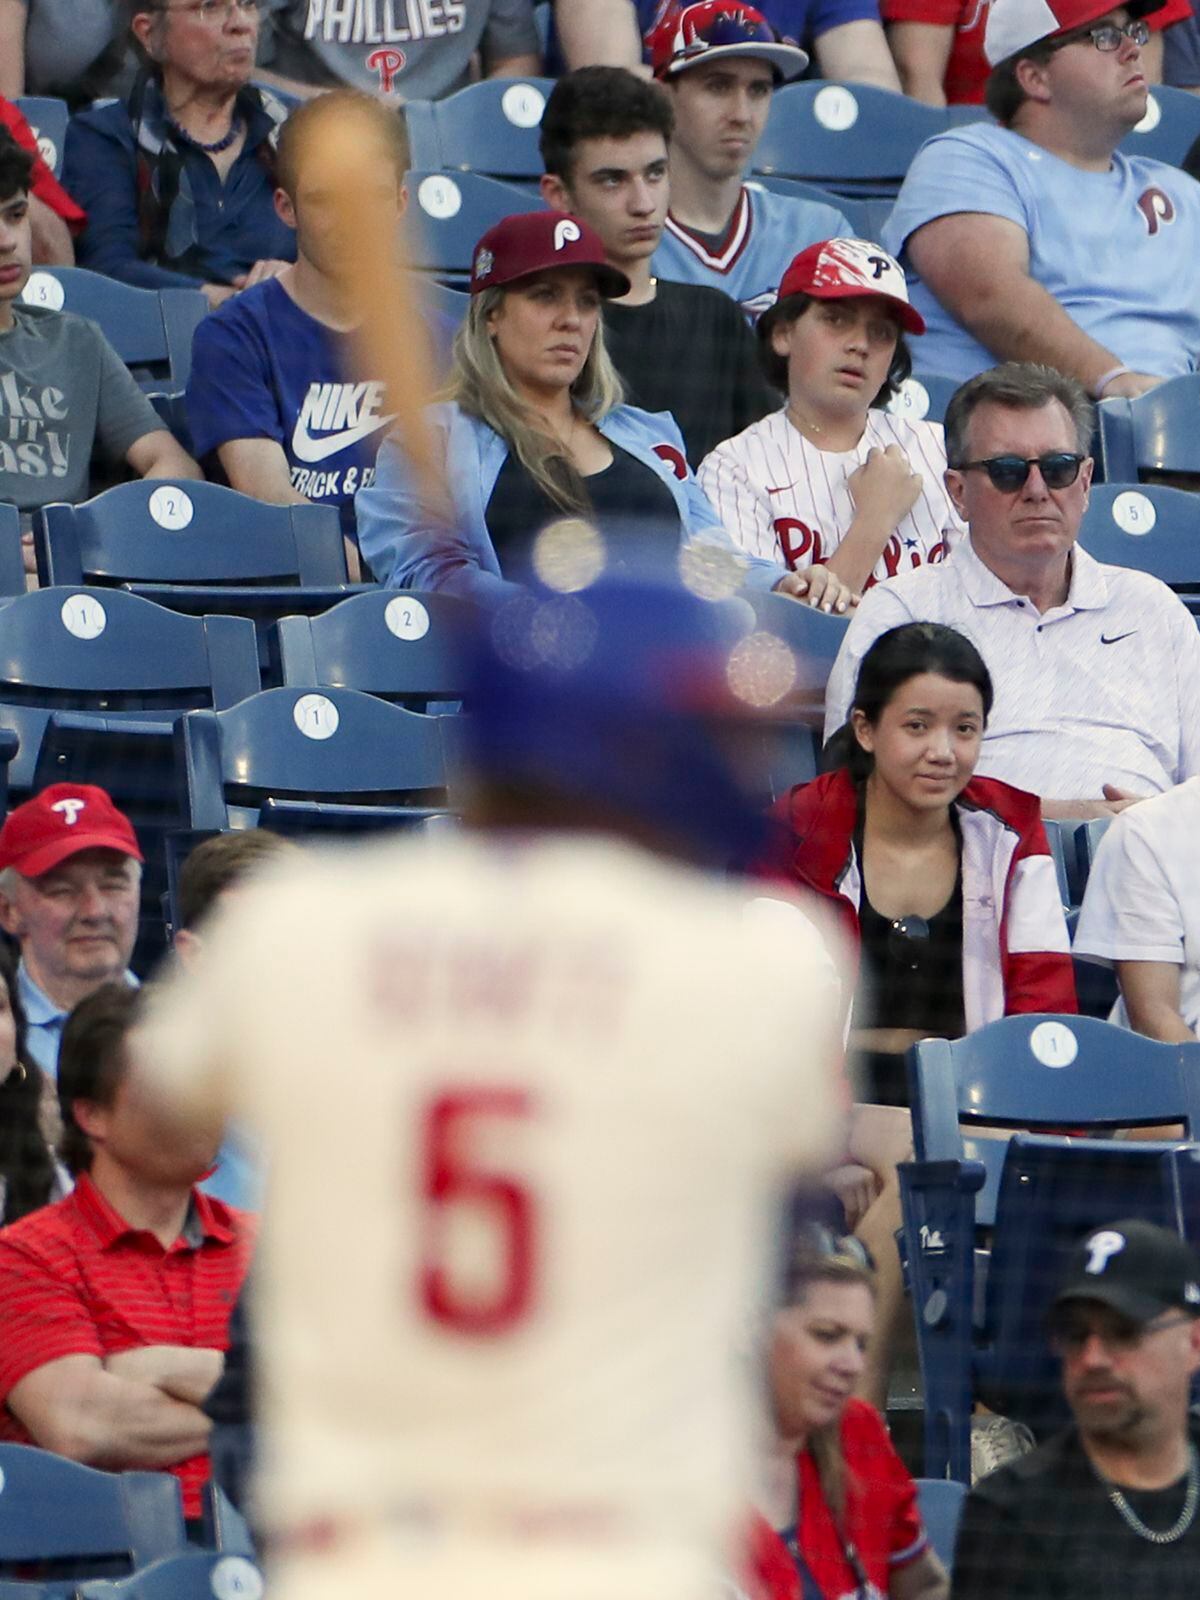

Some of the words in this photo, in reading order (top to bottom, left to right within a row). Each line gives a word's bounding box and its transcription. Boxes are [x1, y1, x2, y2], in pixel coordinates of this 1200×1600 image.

[366, 49, 406, 93] P
[1136, 186, 1174, 237] P
[554, 219, 581, 251] P
[867, 256, 891, 279] P
[39, 287, 47, 301] 3
[299, 381, 386, 431] NIKE
[290, 466, 341, 498] TRACK
[342, 466, 359, 495] &
[166, 500, 176, 516] 2
[1129, 506, 1139, 521] 5
[81, 609, 87, 625] 1
[403, 610, 412, 626] 2
[313, 709, 319, 725] 1
[51, 798, 85, 826] P
[420, 1089, 541, 1332] 5
[1085, 1230, 1126, 1275] P
